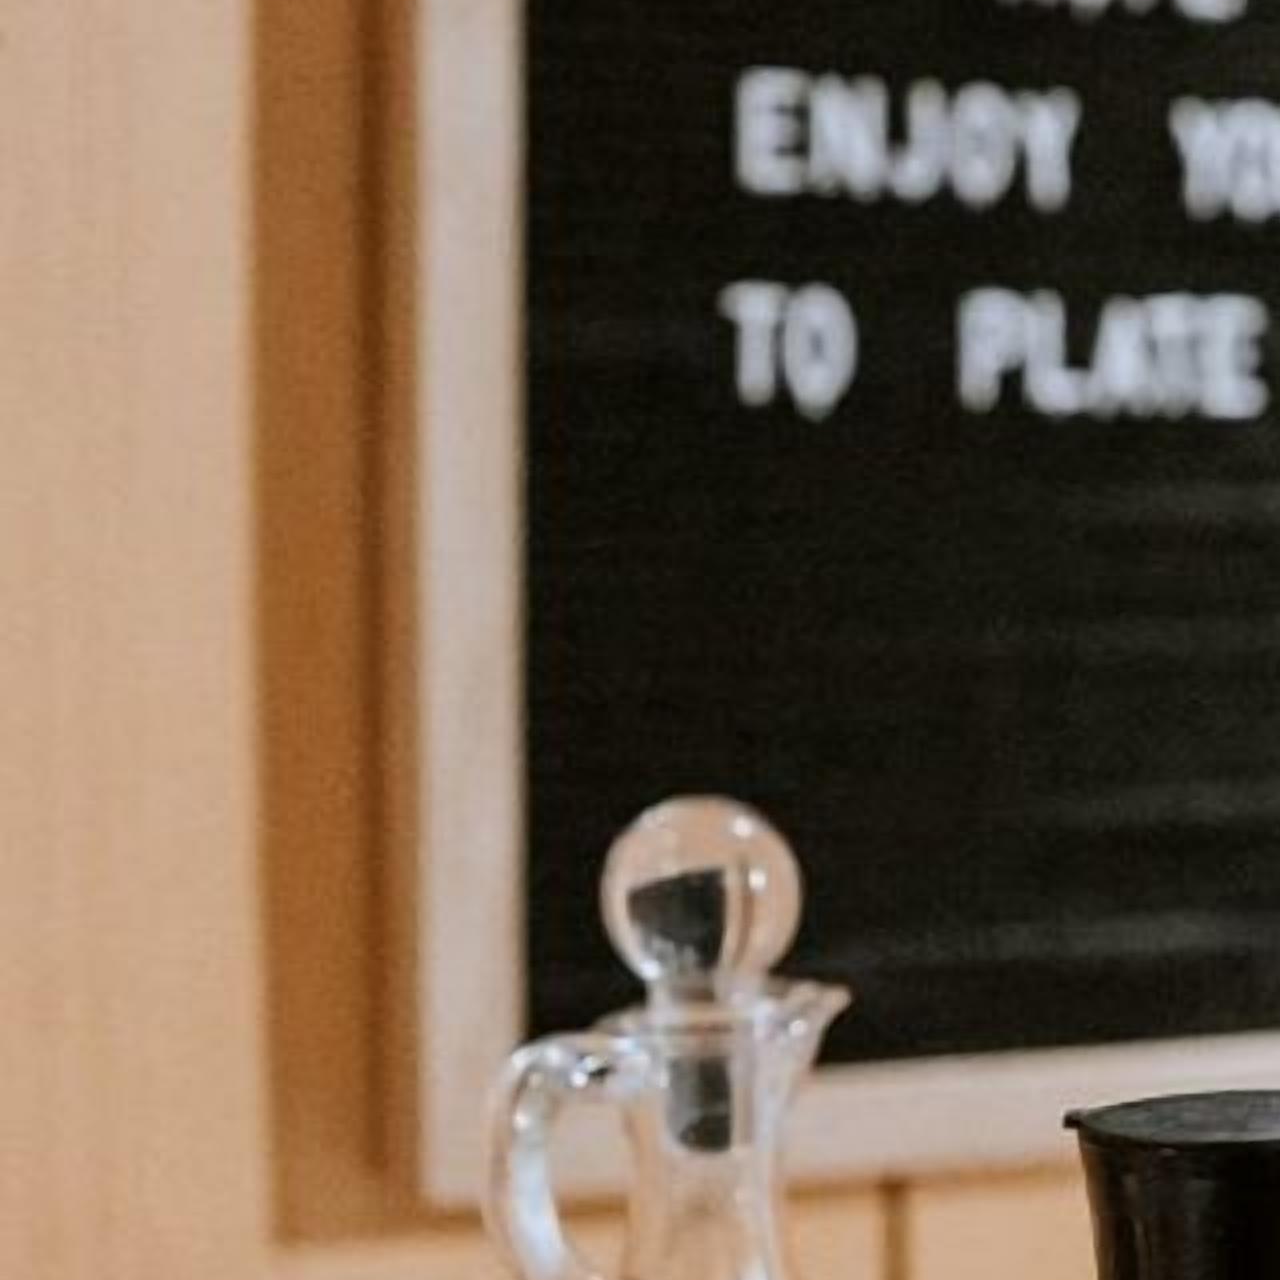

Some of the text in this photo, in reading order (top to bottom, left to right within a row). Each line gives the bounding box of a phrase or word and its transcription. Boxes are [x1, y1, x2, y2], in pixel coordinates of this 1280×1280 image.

[736, 67, 1080, 210] ENJOY
[719, 280, 857, 417] TO
[957, 287, 1268, 420] PLATE
